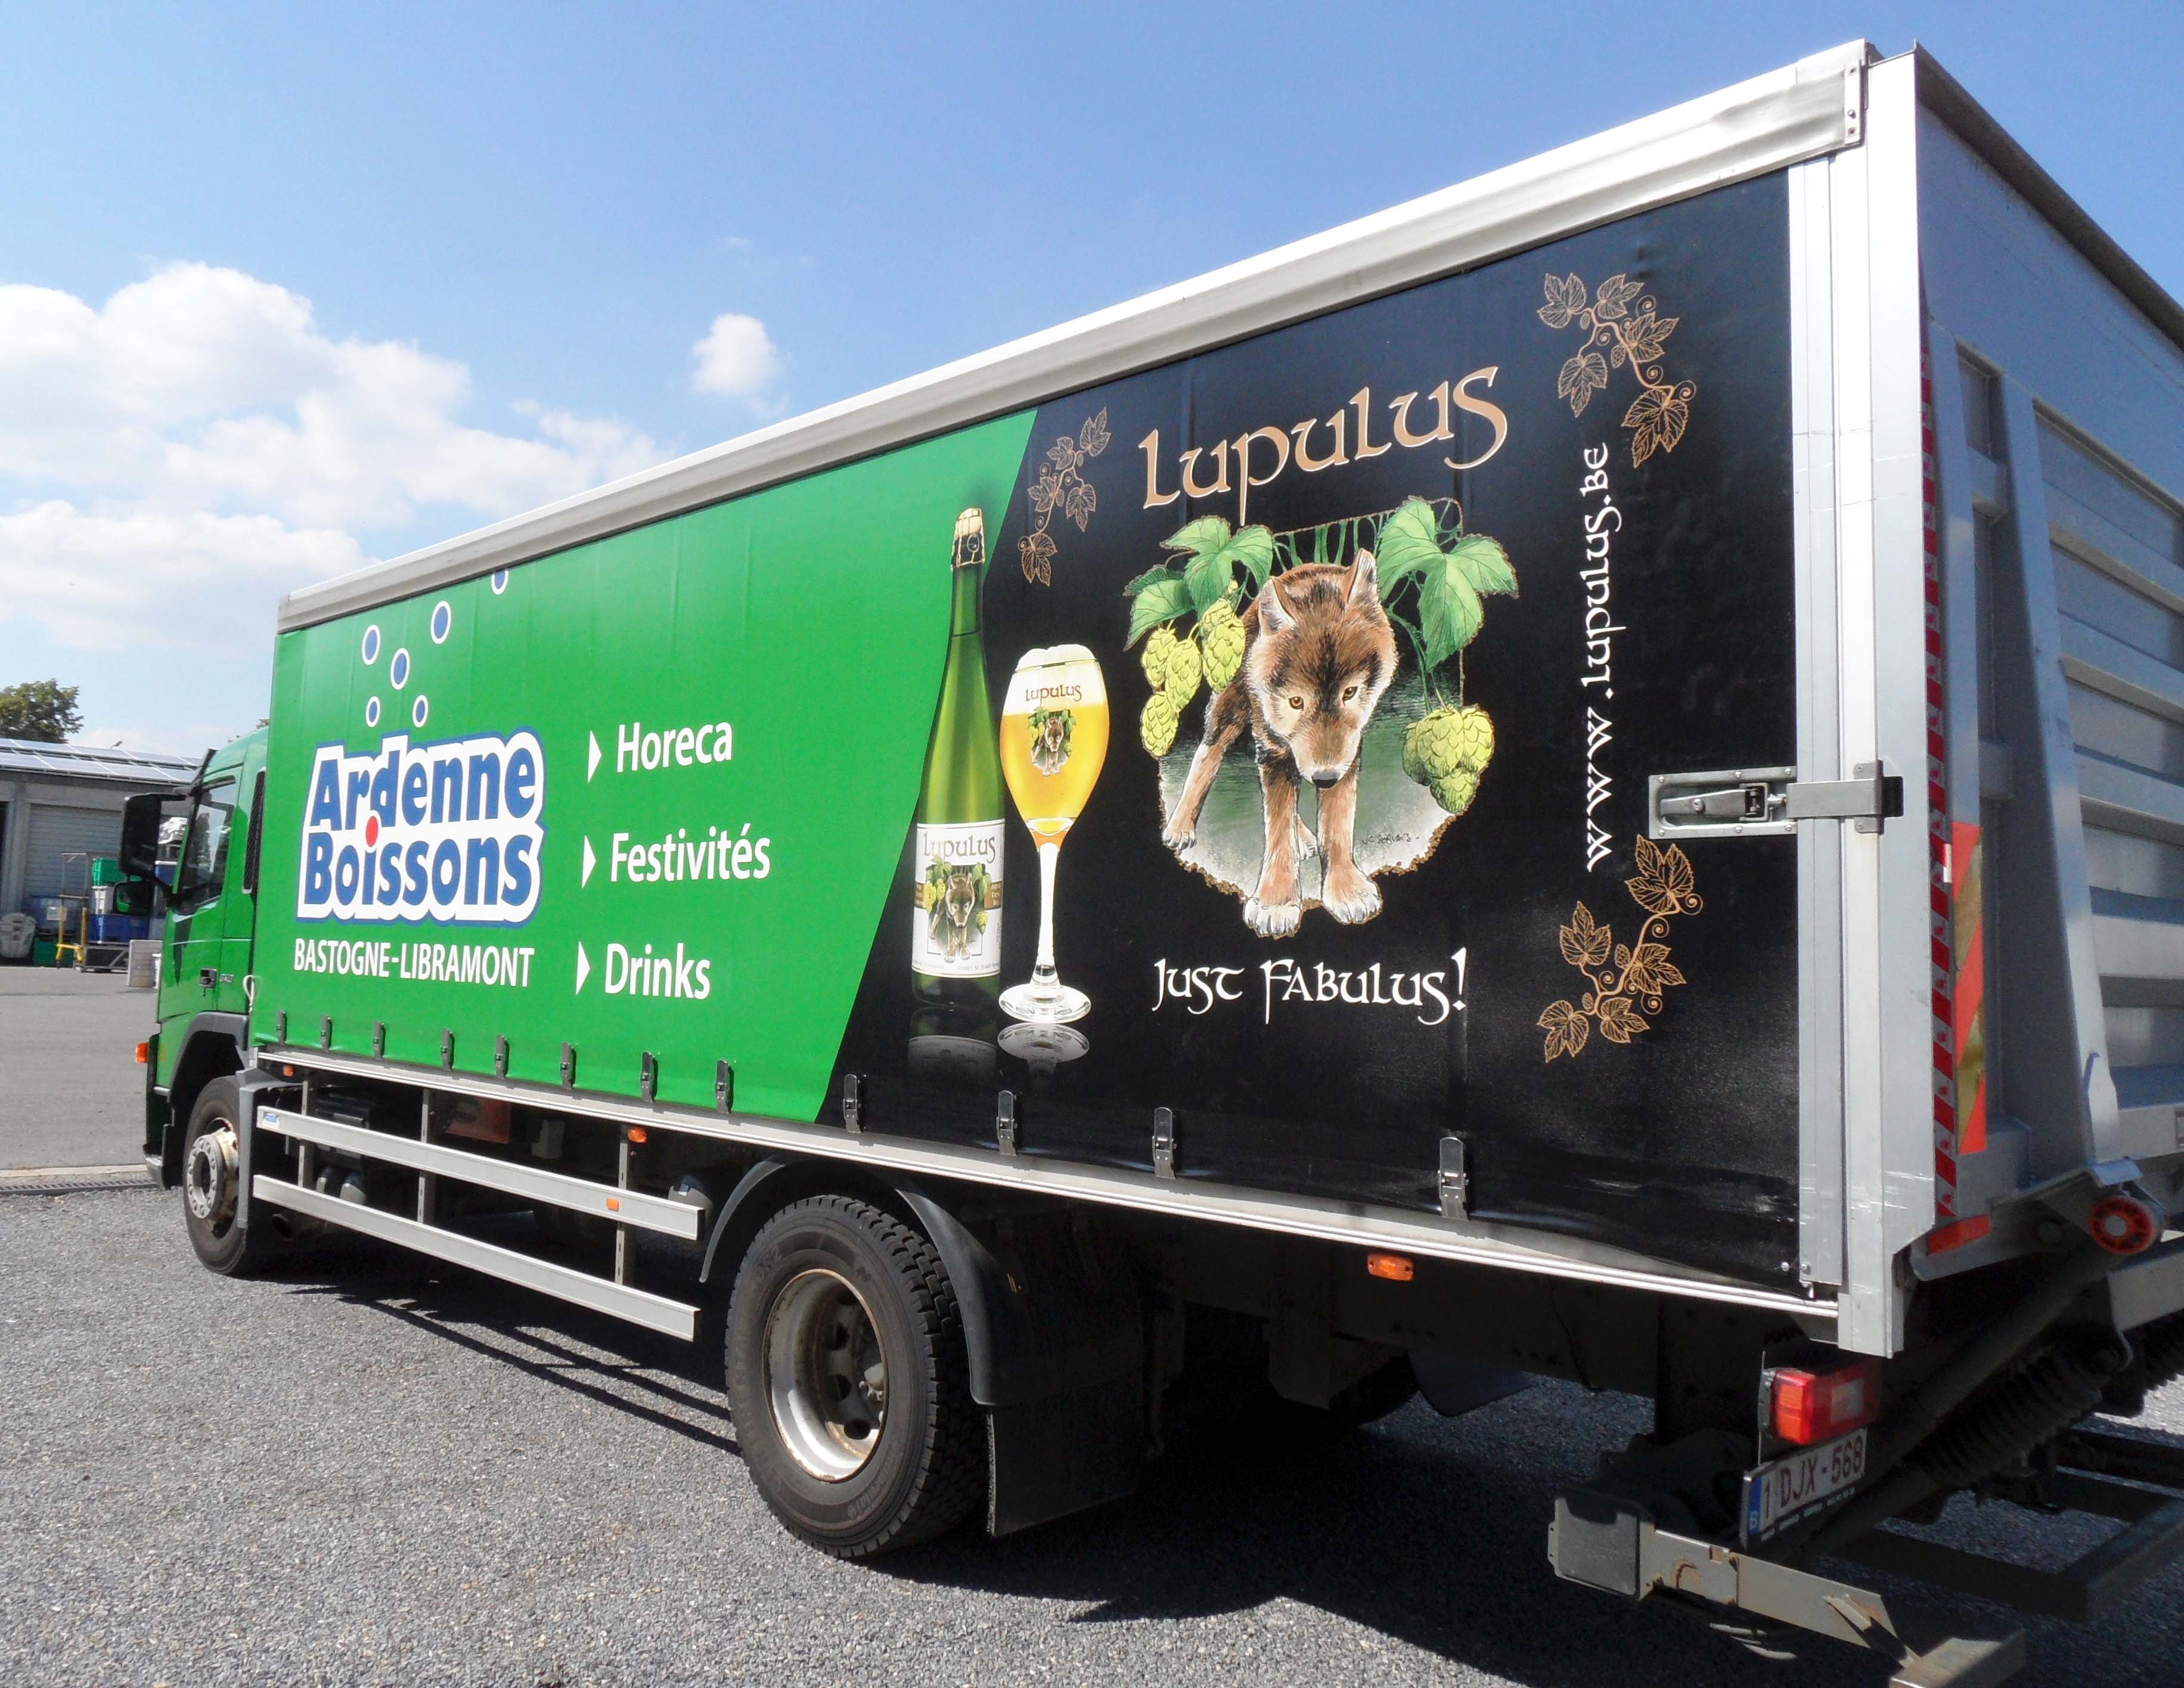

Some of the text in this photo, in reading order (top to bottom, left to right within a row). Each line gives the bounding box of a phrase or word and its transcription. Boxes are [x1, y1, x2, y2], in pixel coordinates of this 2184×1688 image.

[616, 721, 734, 773] Horeca
[308, 745, 537, 831] Ardenne
[303, 818, 534, 908] Boissons
[610, 823, 771, 883] Festivités
[293, 938, 535, 988] BASTOGNE-LIBRAMONT
[604, 942, 712, 1000] Drinks
